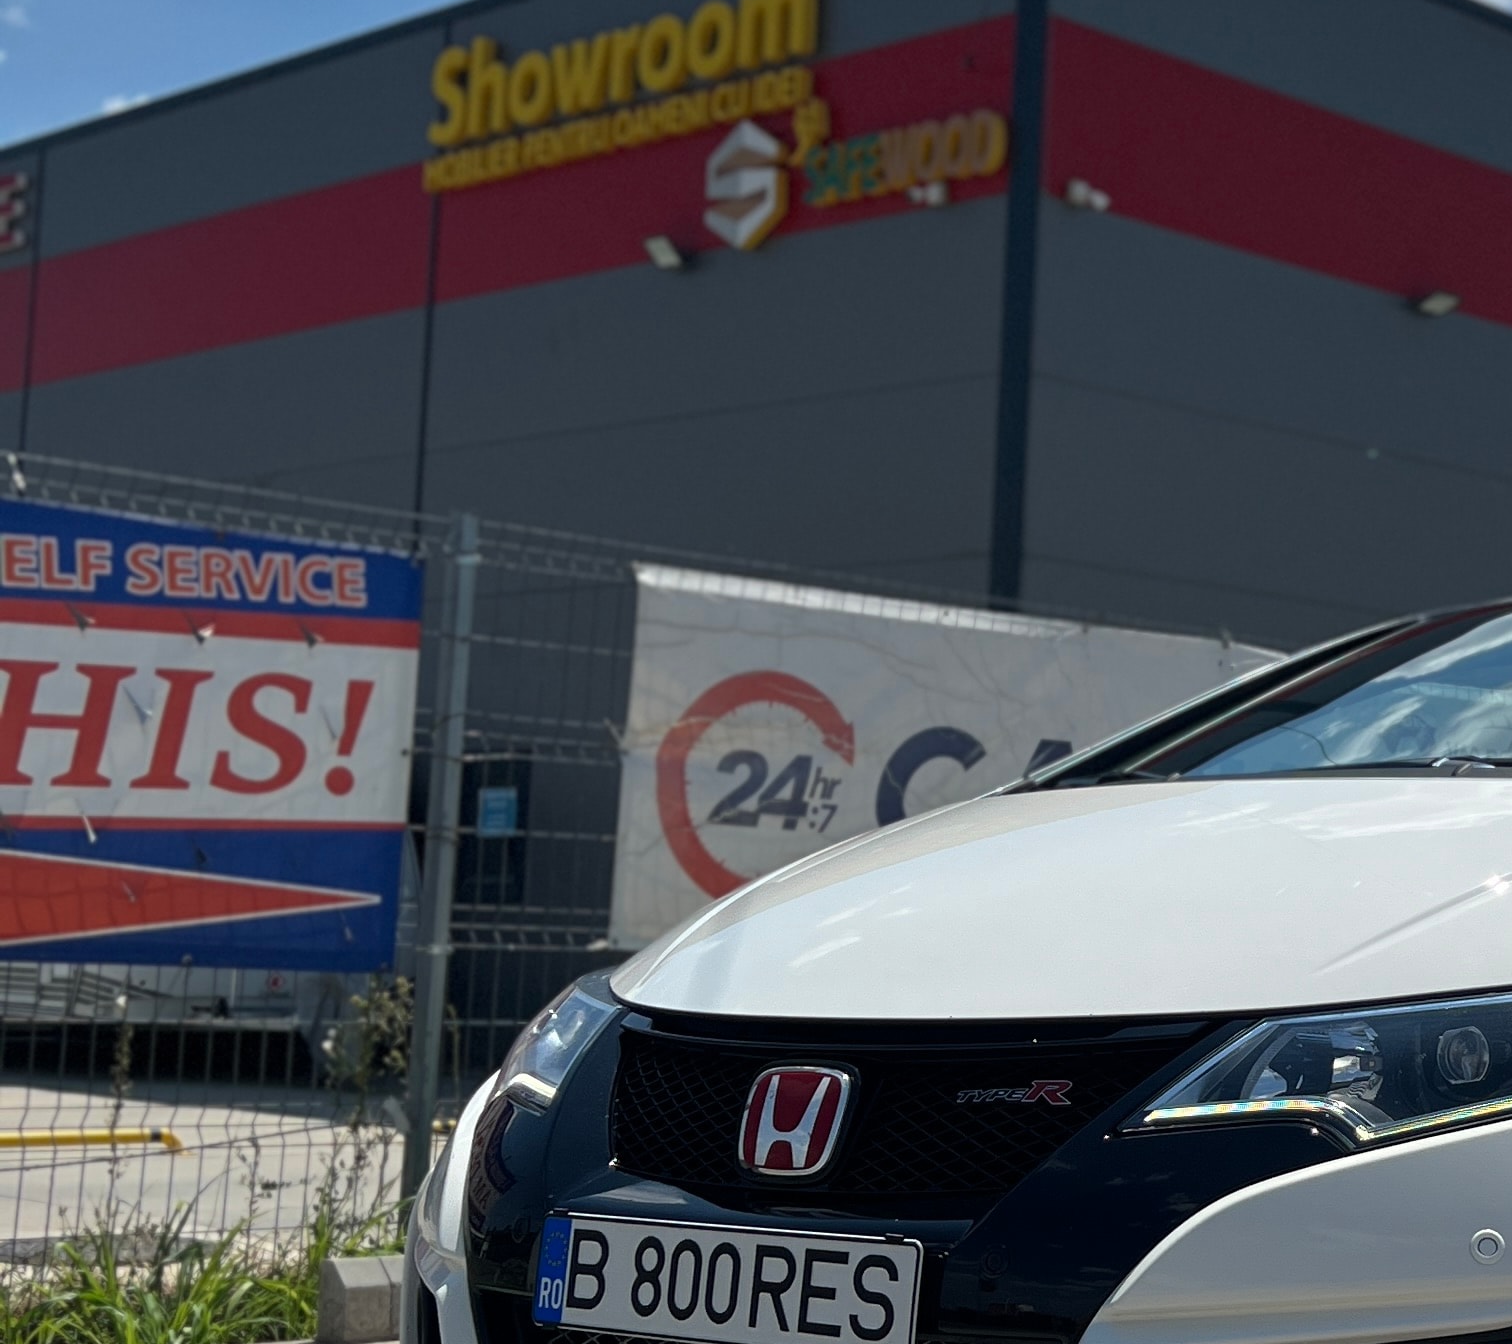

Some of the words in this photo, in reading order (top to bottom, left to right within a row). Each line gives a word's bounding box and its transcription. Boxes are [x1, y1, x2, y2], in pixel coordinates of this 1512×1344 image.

[0, 536, 112, 591] ELF
[126, 543, 366, 607] SERVICE
[0, 659, 375, 798] HIS!
[707, 750, 811, 831] 24
[537, 1275, 562, 1310] RO
[566, 1229, 610, 1310] B
